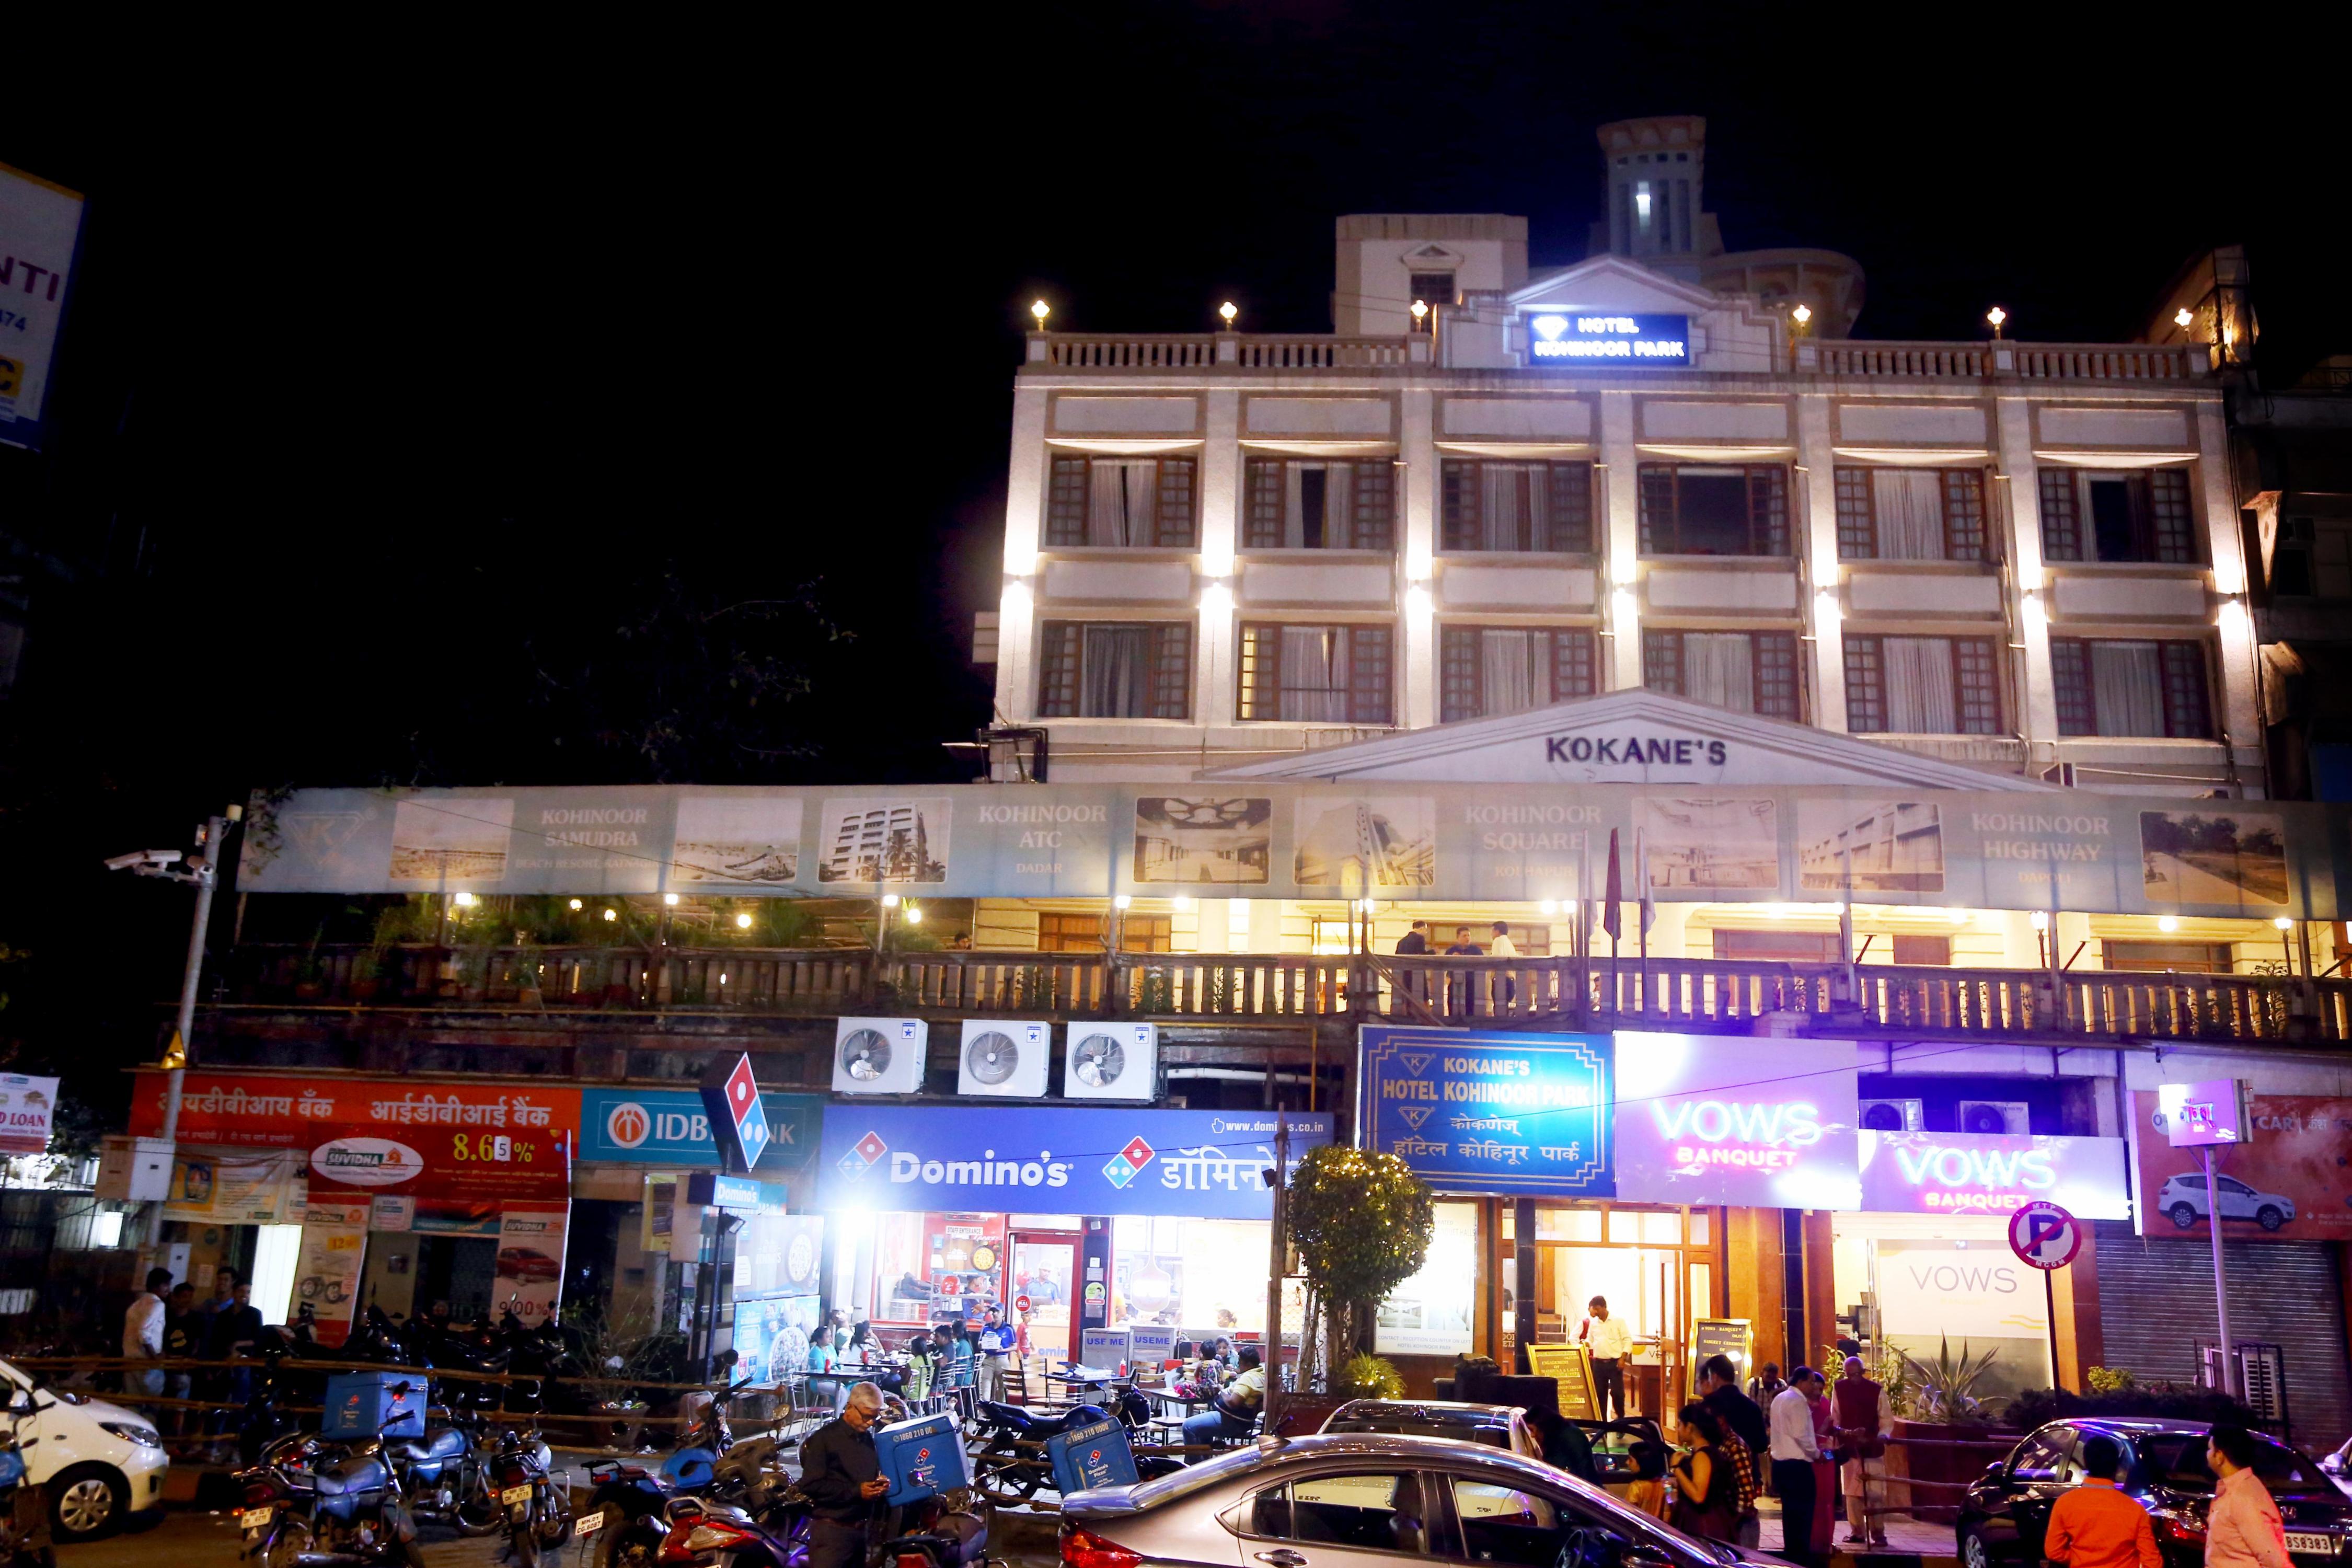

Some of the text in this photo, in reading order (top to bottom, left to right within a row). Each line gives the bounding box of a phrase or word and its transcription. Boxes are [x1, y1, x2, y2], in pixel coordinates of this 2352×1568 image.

[1577, 317, 1640, 333] HOTEL
[1534, 340, 1685, 357] KOHINOOR PARK
[1547, 736, 1727, 766] KOKANE'S
[541, 809, 648, 824] KOHINOOR
[978, 805, 1107, 823] KOHINOOR
[1465, 805, 1602, 824] KOHINOOR
[1971, 813, 2109, 835] KOHINOOR
[545, 831, 639, 847] SAMUDRA
[1019, 831, 1063, 848] ATC
[1483, 832, 1584, 852] SQUARE
[1982, 840, 2101, 861] HIGHWAY
[1016, 863, 1063, 874] DADAR
[1444, 1056, 1530, 1076] KOKANE'S
[1383, 1078, 1589, 1106] HOTEL KOHINOOR PARK
[10, 1113, 46, 1127] LOAN
[370, 1092, 552, 1128] आईडीबीआई बैंक
[1226, 1121, 1323, 1133] www.domis.co.in
[1651, 1098, 1824, 1146] VOWS
[1392, 1135, 1580, 1165] हॉटेल कोहिनूर पार्क
[1676, 1146, 1797, 1167] BANQUET
[890, 1149, 1068, 1187] Domino's
[1895, 1146, 2057, 1189] VOWS
[717, 1183, 757, 1203] Domino's
[1924, 1192, 2030, 1209] BANQUET
[2035, 1259, 2066, 1267] MCGM
[1908, 1264, 2018, 1294] VOWS
[1087, 1338, 1106, 1346] USE
[900, 1431, 913, 1441] 1860
[914, 1428, 925, 1437] 210
[1071, 1423, 1109, 1443] 1860 210 0000
